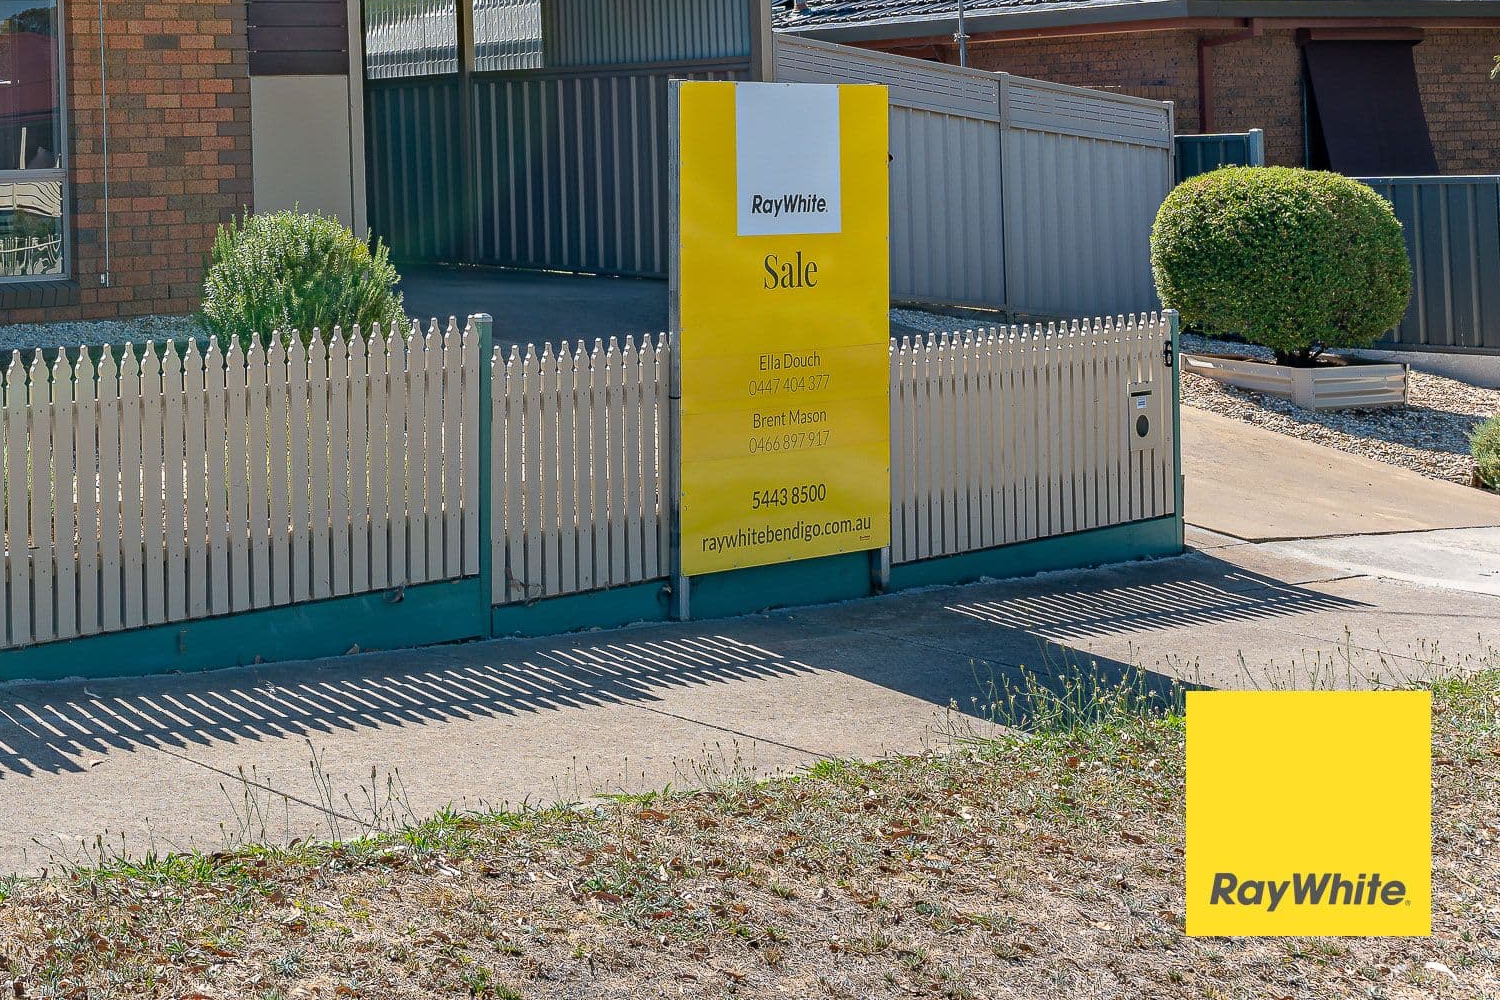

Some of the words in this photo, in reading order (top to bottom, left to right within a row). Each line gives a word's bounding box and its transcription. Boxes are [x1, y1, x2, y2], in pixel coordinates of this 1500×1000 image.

[763, 251, 818, 289] Sale
[759, 354, 780, 371] Ella
[783, 351, 821, 369] Douch
[749, 378, 780, 396] 0447
[783, 376, 805, 393] 404
[808, 374, 830, 391] 377
[753, 413, 786, 429] Brent
[789, 409, 827, 426] Mason
[749, 436, 780, 453] 0466
[783, 432, 805, 449] 897
[808, 430, 830, 447] 917
[752, 488, 788, 509] 5443
[791, 483, 826, 504] 8500
[702, 516, 871, 553] raywhitebendigo.com.au
